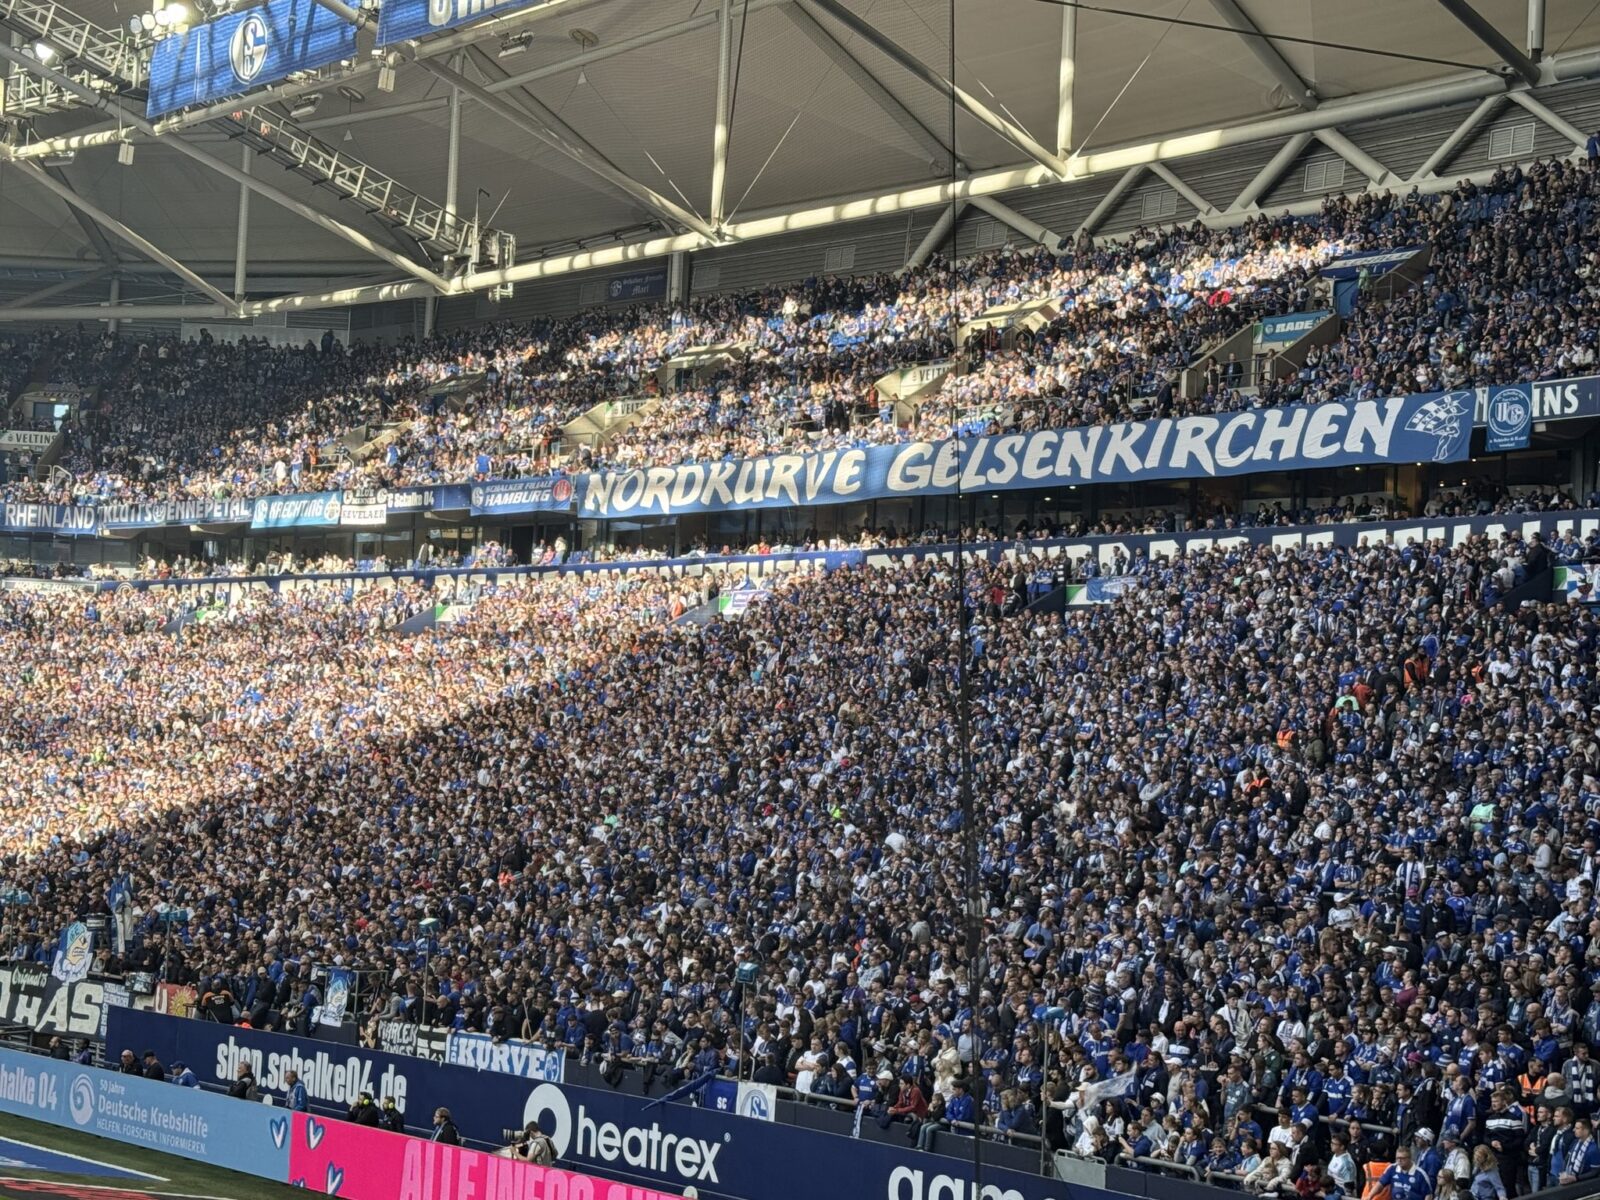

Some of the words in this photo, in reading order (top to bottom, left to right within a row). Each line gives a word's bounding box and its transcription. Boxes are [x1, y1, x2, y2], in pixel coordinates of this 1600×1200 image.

[584, 450, 866, 515] NORDKURVE
[886, 397, 1405, 491] GELSENKIRCHEN
[485, 482, 524, 493] SCHALKER
[485, 489, 551, 506] HAMBURG
[5, 504, 95, 529] RHEINLAND
[167, 499, 249, 521] ENNEPETAL
[457, 1037, 546, 1081] KURVE
[38, 1071, 57, 1111] 04
[100, 1079, 108, 1091] 50
[108, 1081, 126, 1095] Jahre
[98, 1095, 147, 1123] Deutsche
[150, 1107, 208, 1138] Krebshilfe
[96, 1118, 121, 1133] HELFEN.
[122, 1124, 158, 1141] FORSCHEN.
[159, 1132, 207, 1154] INFORMIEREN.
[576, 1105, 721, 1183] heatrex
[400, 1139, 478, 1200] ALLE
